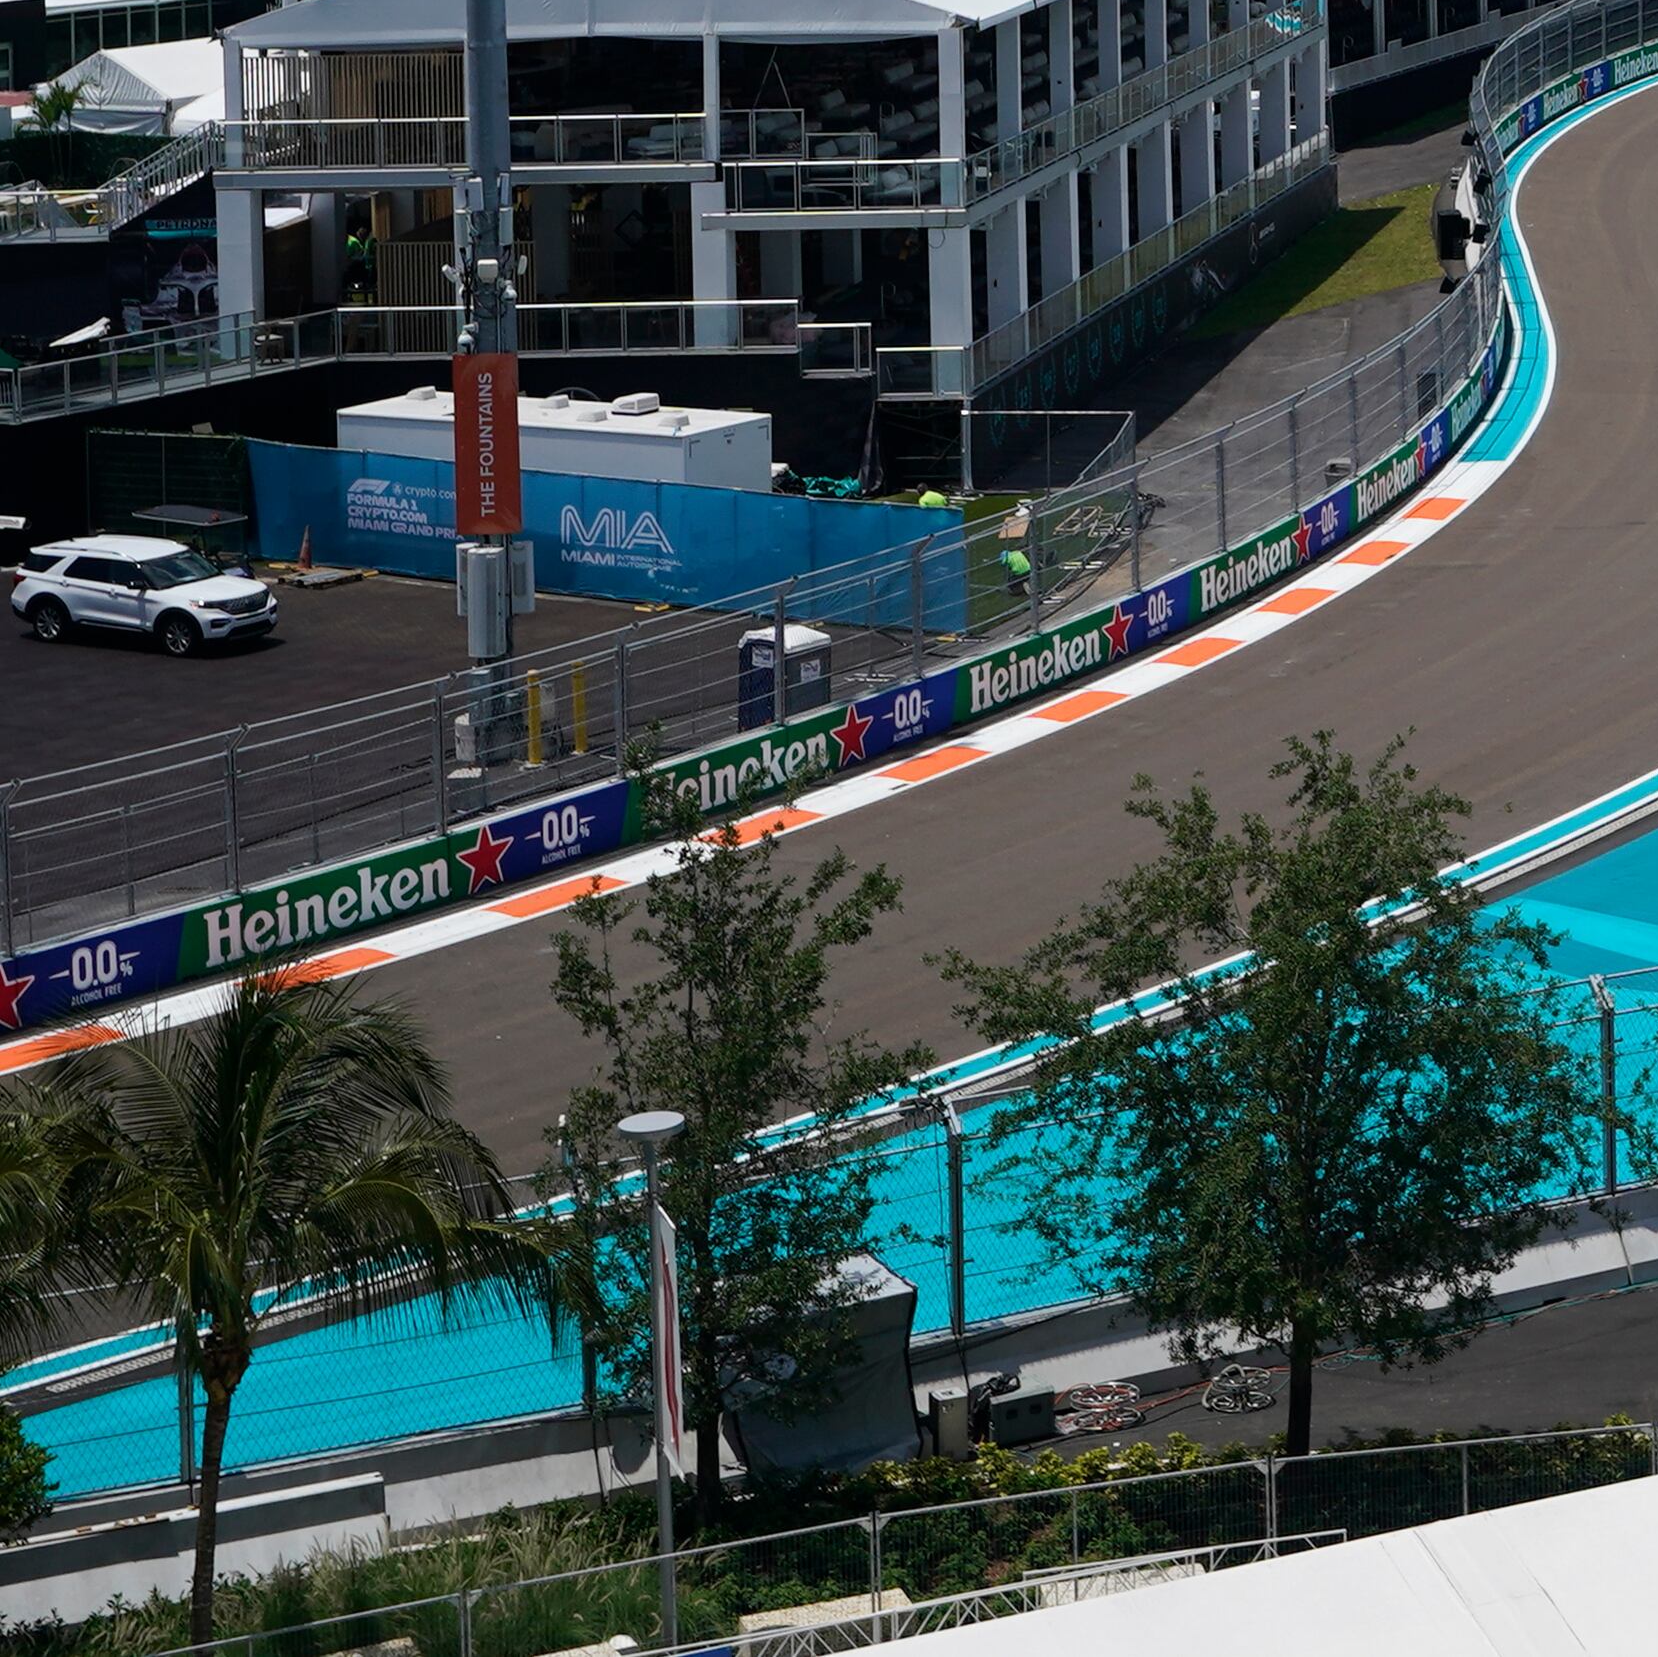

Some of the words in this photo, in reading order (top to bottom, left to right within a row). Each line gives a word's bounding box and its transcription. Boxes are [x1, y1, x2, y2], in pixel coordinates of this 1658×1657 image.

[1614, 50, 1658, 86] Heineken
[478, 372, 495, 477] FOUNTAINS
[347, 493, 408, 510] FORMULA
[411, 499, 418, 511] 1
[480, 480, 496, 517] THE
[1356, 453, 1416, 522] Heineken
[347, 505, 428, 524] CRYPTO.COM
[347, 518, 390, 532] MIAMI
[390, 522, 434, 537] GRAND
[560, 504, 674, 555] MIA
[560, 548, 615, 567] MIAMI
[616, 554, 683, 567] INTERNATIONAL
[1200, 535, 1292, 613] Heineken
[970, 629, 1102, 714] Heineken
[893, 729, 911, 742] ALCOHOL
[912, 724, 924, 736] FREE
[541, 849, 567, 866] ALCOHOL
[567, 843, 582, 858] FREE
[203, 856, 452, 969] Heineken
[71, 989, 103, 1007] ALCOHOL
[104, 981, 123, 998] FREE
